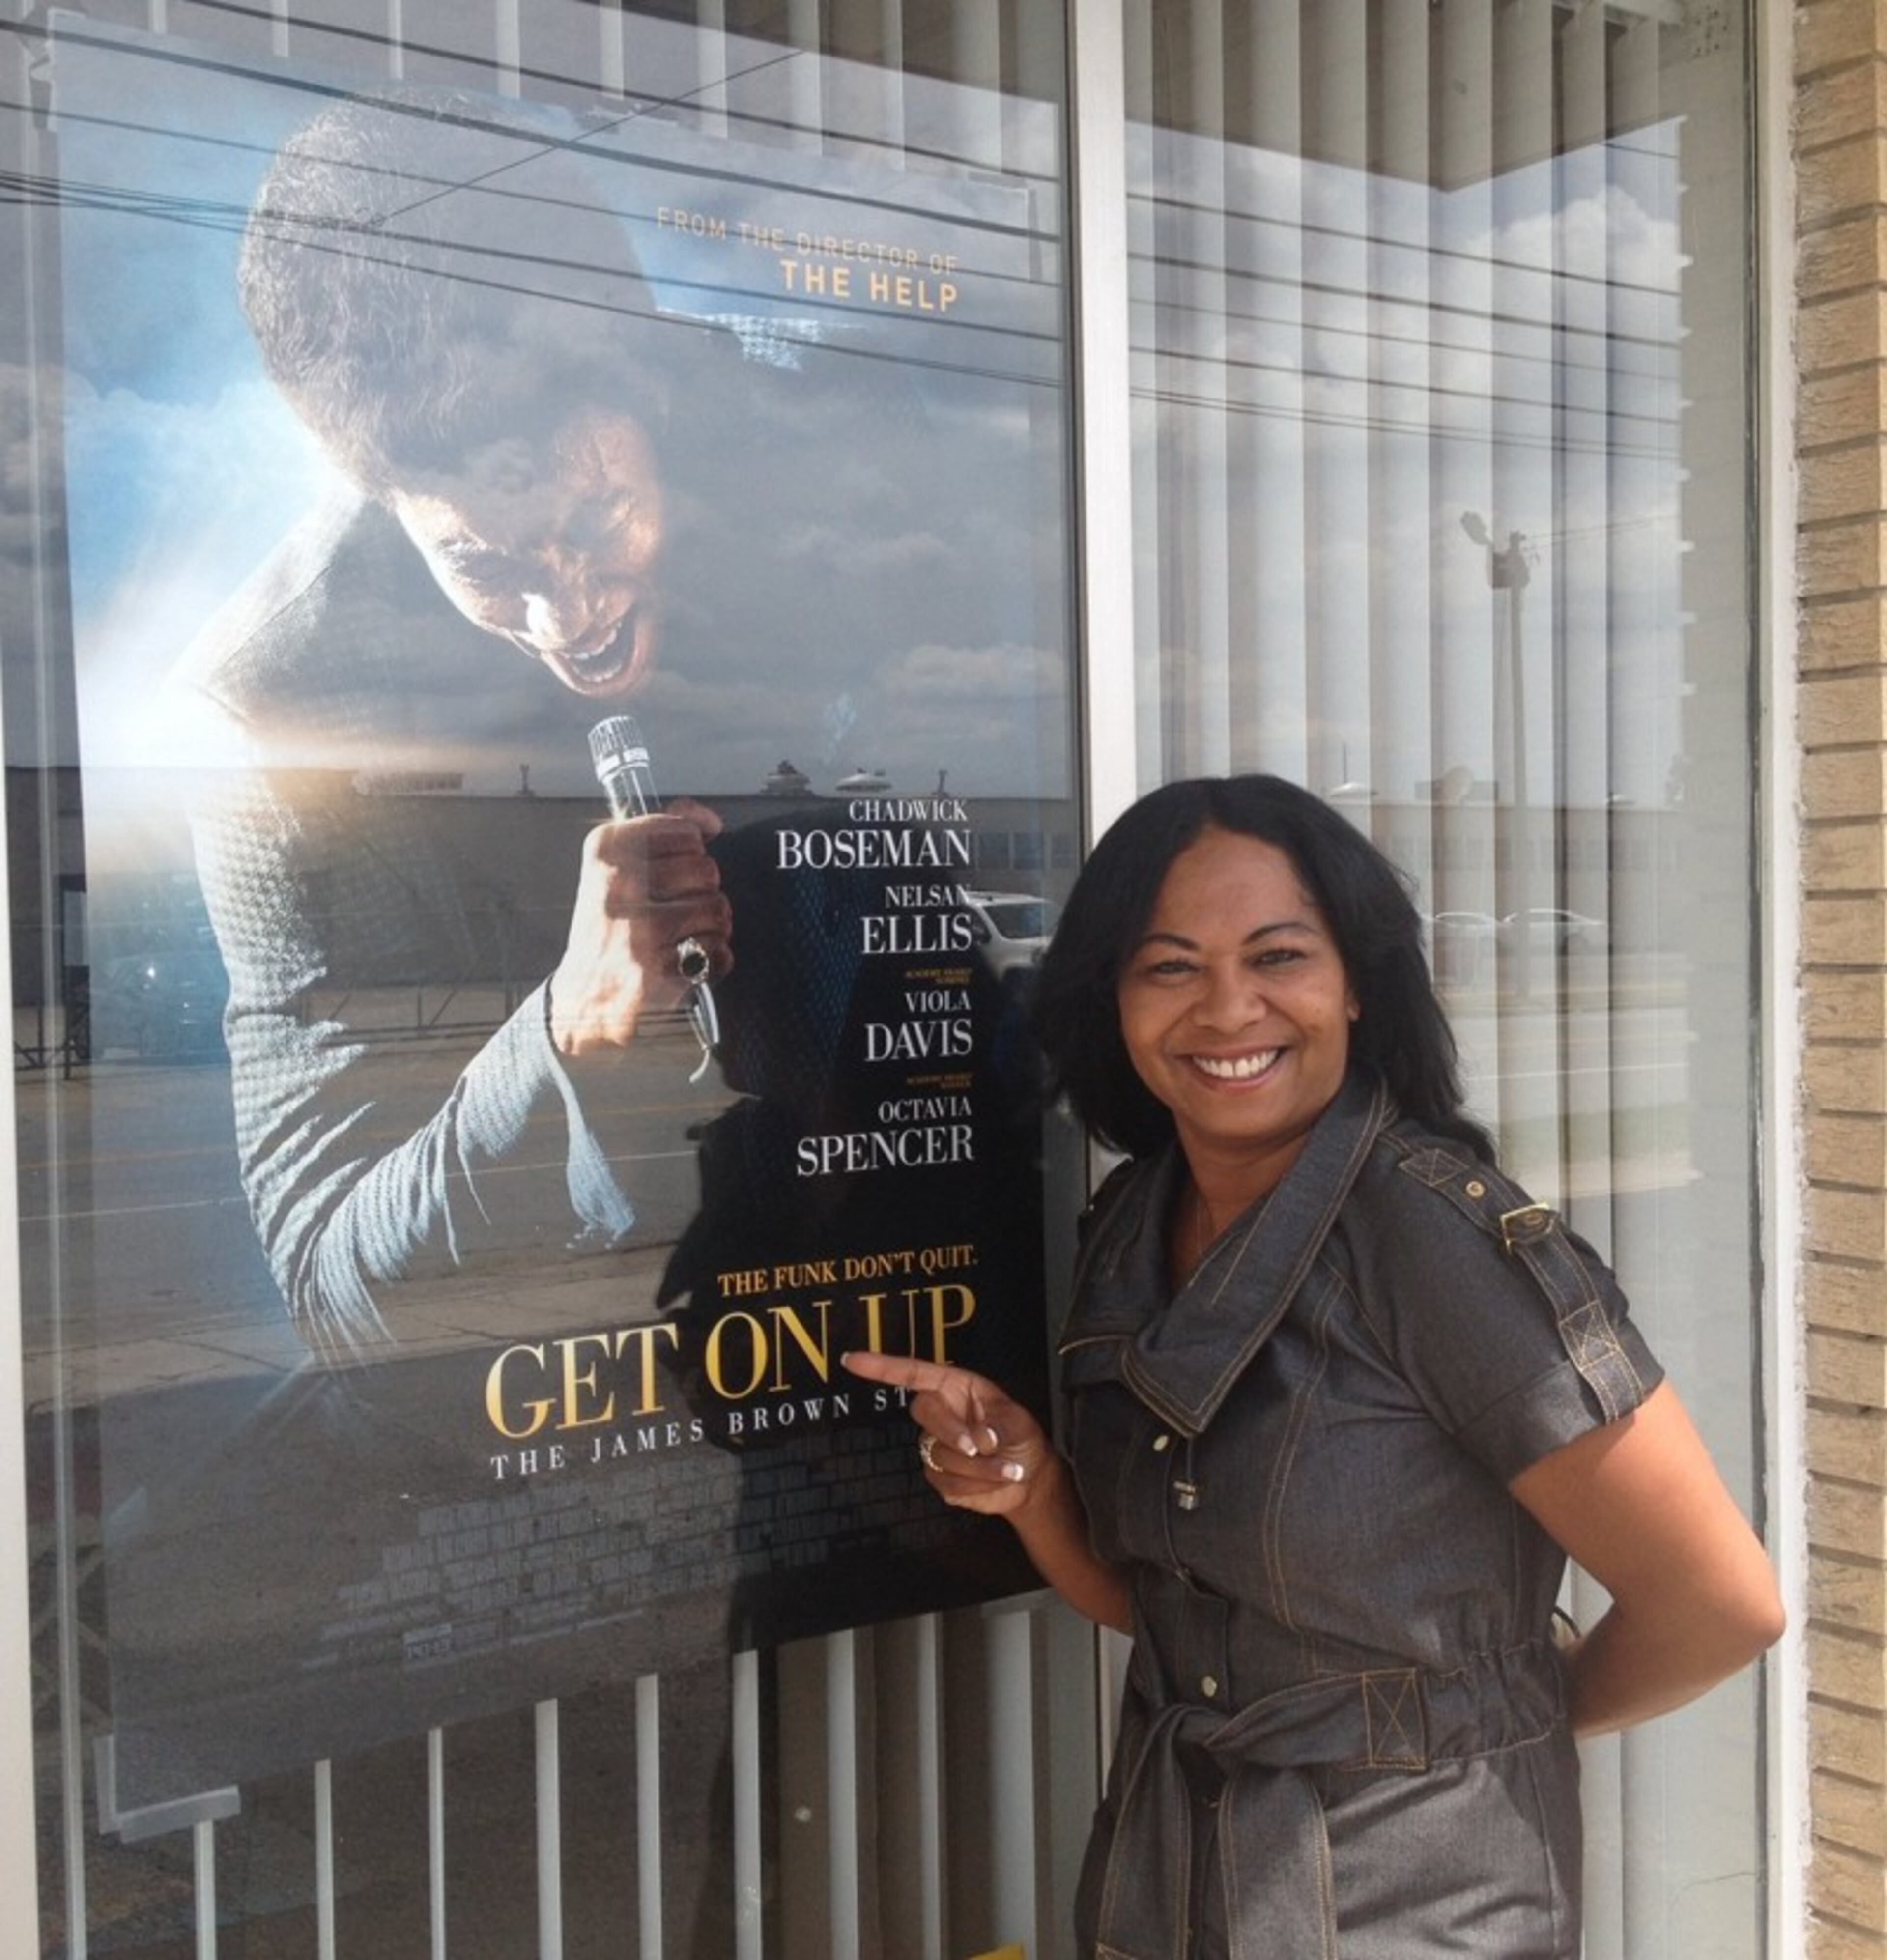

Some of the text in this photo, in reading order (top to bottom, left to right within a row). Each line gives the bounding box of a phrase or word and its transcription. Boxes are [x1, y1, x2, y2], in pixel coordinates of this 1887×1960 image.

[658, 206, 958, 275] FROM THE DIRECTOR OF
[780, 259, 957, 312] THE HELP
[849, 799, 968, 822] CHADWICK
[775, 829, 971, 869] BOSEMAN
[885, 884, 971, 909] NELSAN
[861, 913, 972, 954] ELLIS
[905, 990, 972, 1013] VIOLA
[864, 1018, 973, 1062] DAVIS
[878, 1096, 972, 1123] OCTAVIA
[797, 1124, 975, 1176] SPENCER
[717, 1245, 978, 1297] THE FUNK DON'T QUIT.
[485, 1284, 976, 1439] GET ON UP
[490, 1445, 566, 1480] THE
[591, 1418, 705, 1463] JAMES
[728, 1393, 850, 1435] BROWN
